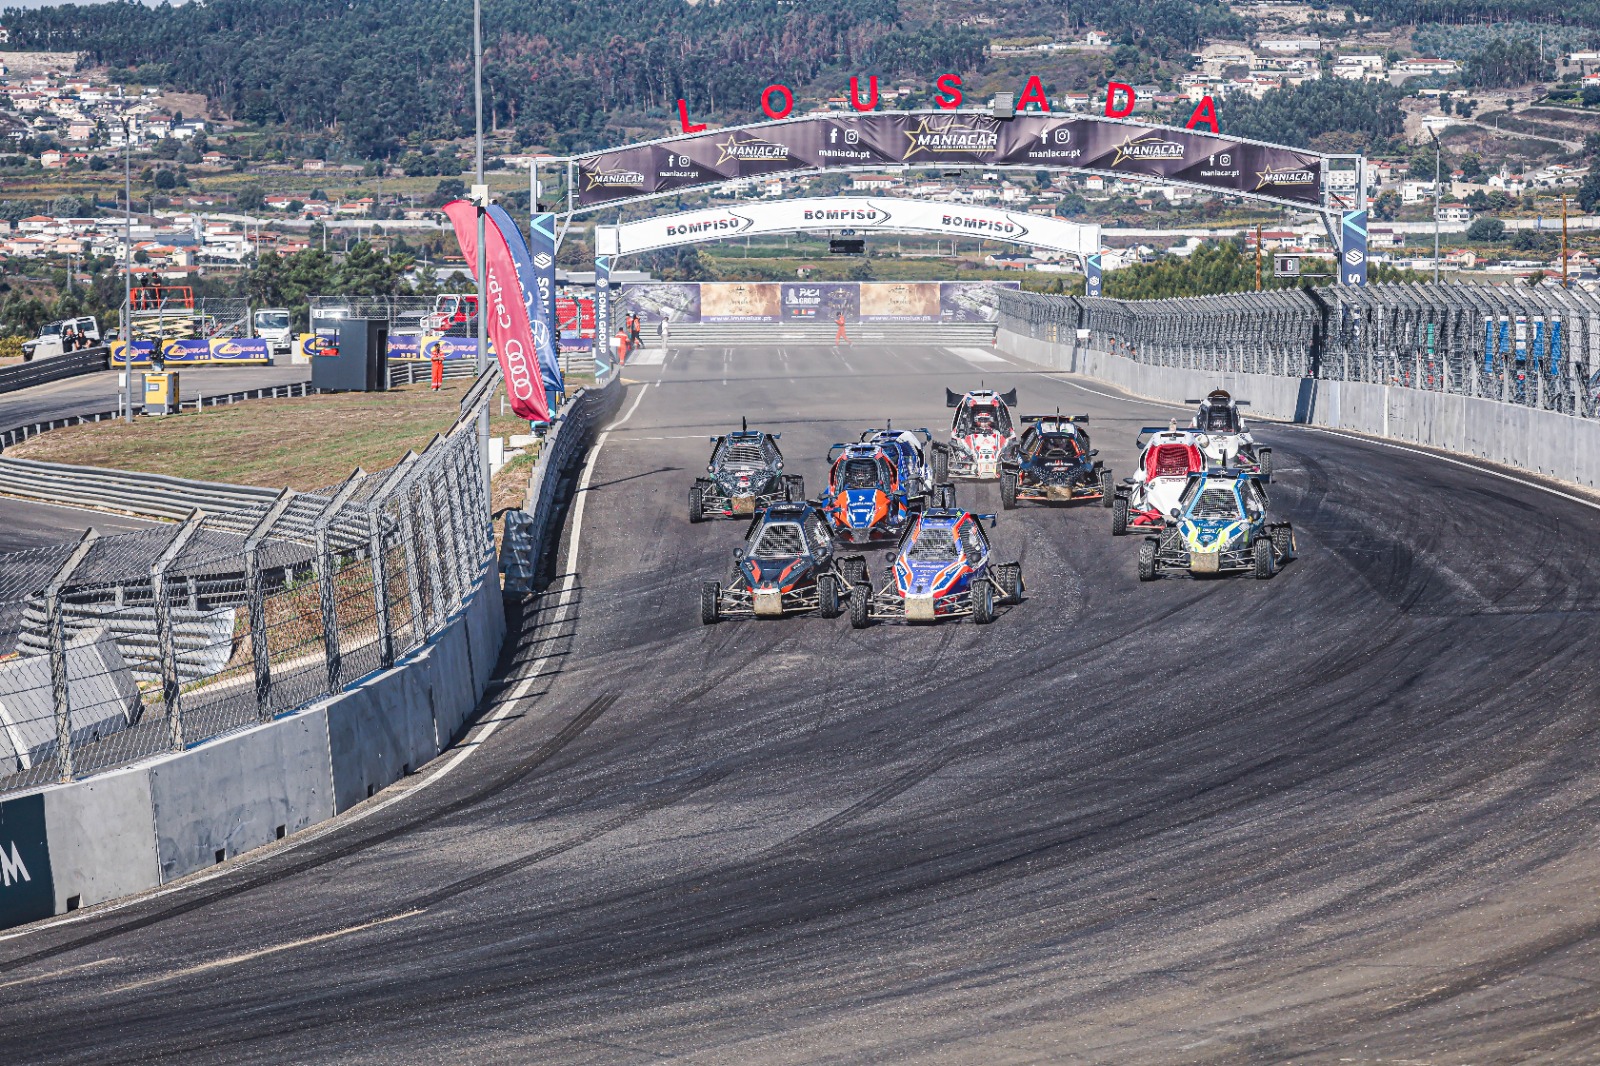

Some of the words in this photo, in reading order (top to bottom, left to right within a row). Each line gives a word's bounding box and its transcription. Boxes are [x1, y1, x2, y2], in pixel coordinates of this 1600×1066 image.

[677, 73, 1219, 134] LOUSADA
[917, 134, 998, 146] MANIACAR
[726, 146, 790, 156] MANIACAR
[818, 149, 871, 160] maniacar.pt
[1028, 149, 1081, 158] maniacar.pt
[1122, 144, 1185, 155] MANIACAR
[594, 174, 645, 183] MANIACAR
[660, 170, 699, 178] maniacar.pt
[1200, 169, 1240, 178] maniacar.pt
[1264, 172, 1314, 182] MANIACAR
[804, 209, 877, 220] BOMPISO
[666, 217, 739, 236] BOMPISO
[941, 215, 1014, 233] BOMPISO
[799, 288, 820, 297] PACA
[598, 292, 606, 319] SOMA
[598, 321, 606, 354] GROUP
